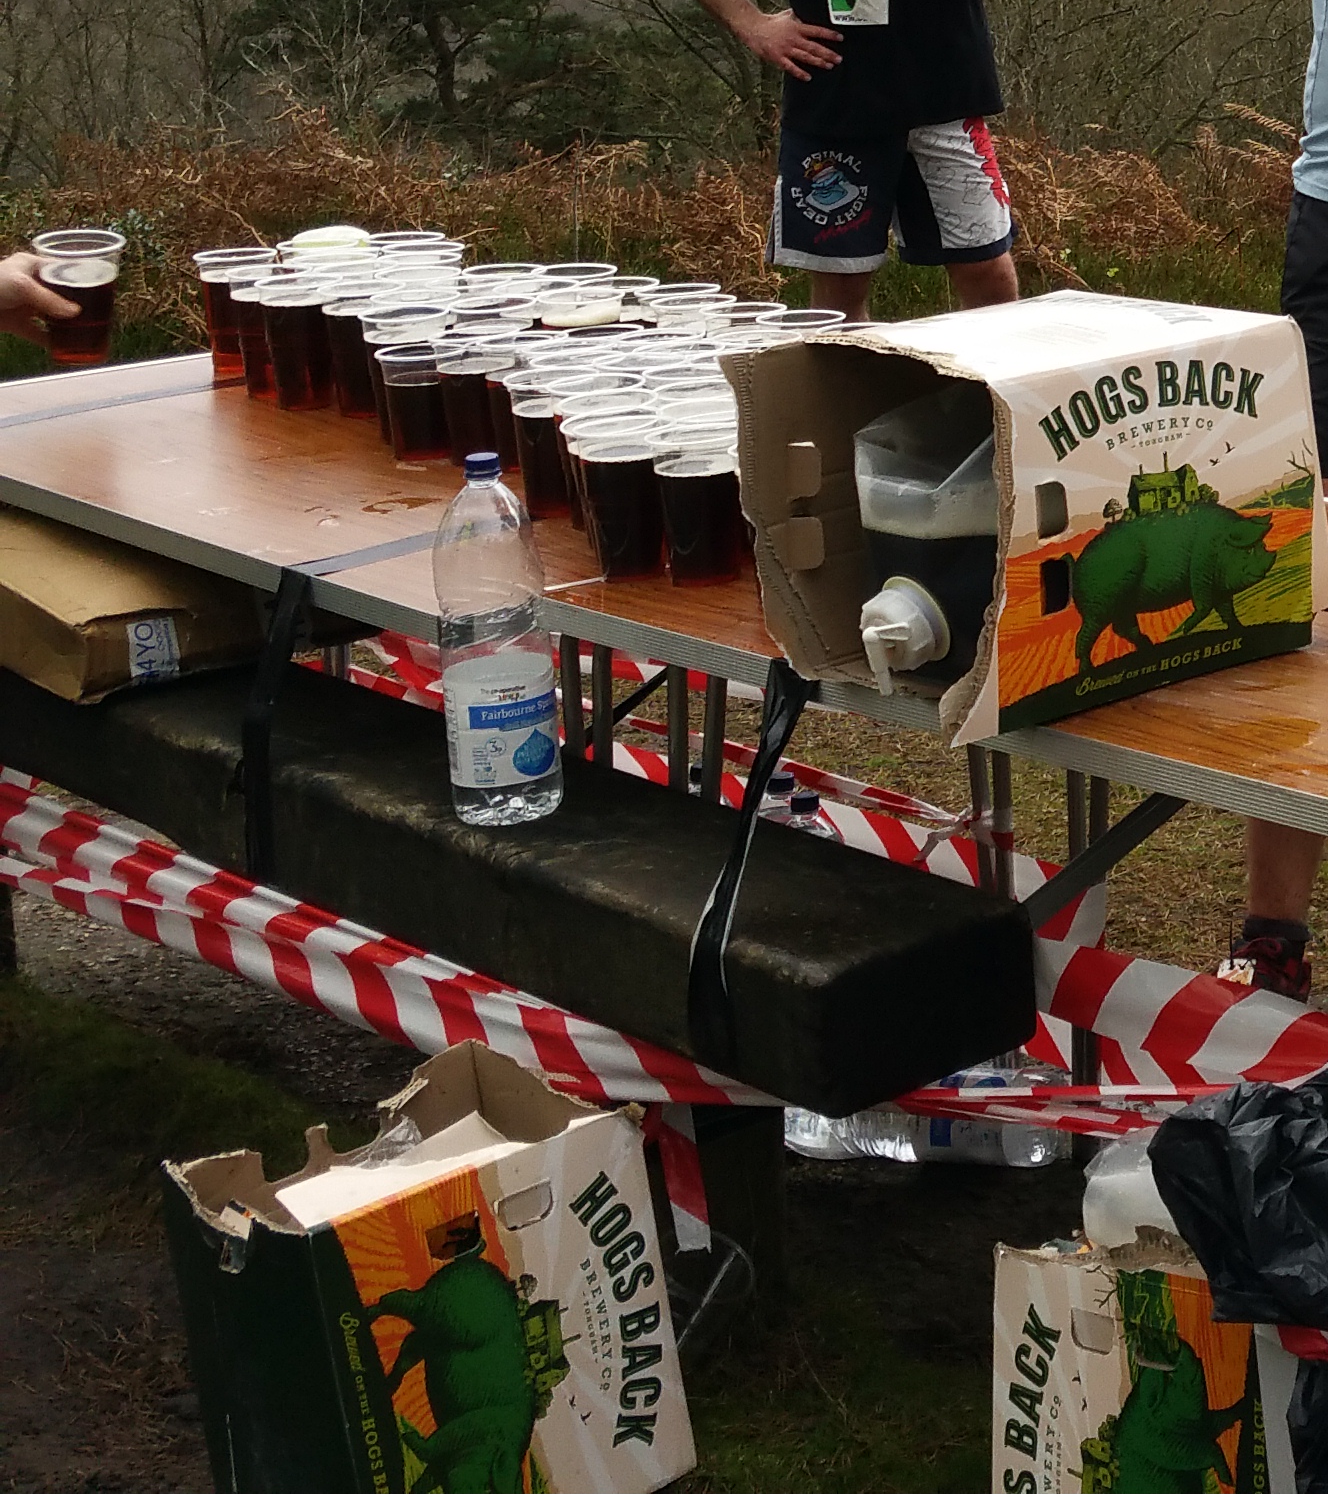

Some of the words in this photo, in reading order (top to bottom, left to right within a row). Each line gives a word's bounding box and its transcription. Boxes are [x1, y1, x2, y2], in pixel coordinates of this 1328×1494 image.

[802, 151, 862, 174] PRIMAL
[835, 186, 868, 226] FIGHT
[1038, 365, 1150, 462] HOGS
[1155, 359, 1264, 419] BACK
[1106, 416, 1191, 451] BREWERY
[1160, 650, 1200, 672] HOGS
[1203, 637, 1243, 659] BACK
[481, 704, 535, 722] Fairbourne
[569, 1170, 655, 1304] HOGS
[612, 1300, 664, 1449] BACK
[579, 1258, 613, 1361] BREWERY
[1004, 1302, 1062, 1461] BACK
[362, 1417, 384, 1471] HOGS
[1042, 1424, 1057, 1494] WERY
